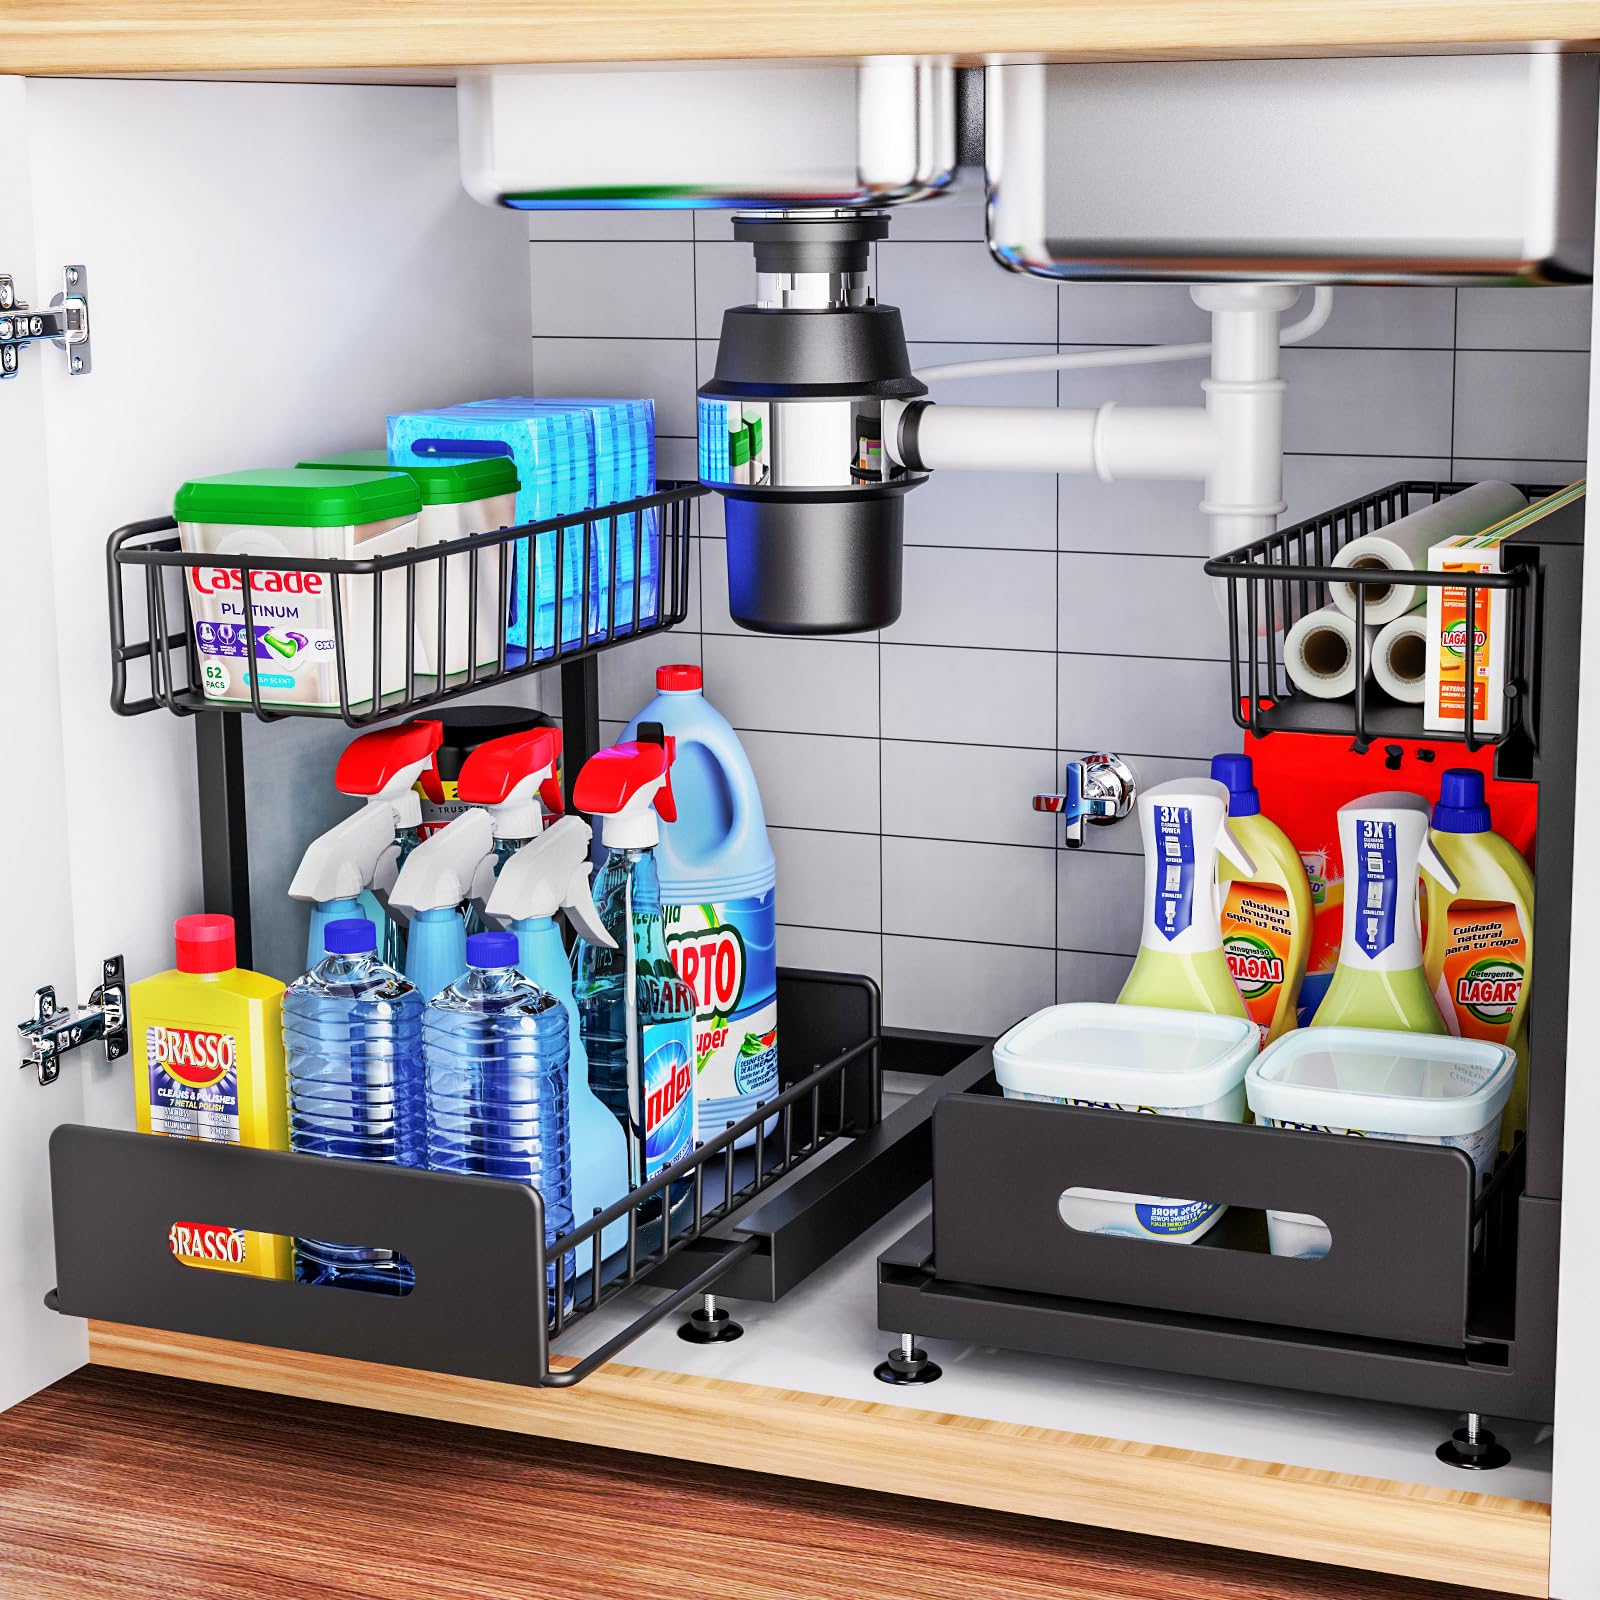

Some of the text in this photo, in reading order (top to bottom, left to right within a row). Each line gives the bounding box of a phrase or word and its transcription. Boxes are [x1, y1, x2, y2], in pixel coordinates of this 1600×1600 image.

[206, 667, 222, 679] 62
[206, 681, 225, 689] PACS
[439, 805, 483, 814] TRUST
[1161, 806, 1180, 823] 3X
[1363, 822, 1383, 838] 3X
[1364, 842, 1385, 850] POWER
[1453, 922, 1502, 936] Cuidado
[1457, 930, 1503, 944] natural
[1445, 944, 1470, 957] para
[1490, 938, 1519, 947] ropa
[1471, 970, 1514, 979] Detergente
[154, 1026, 234, 1071] BRASSO
[696, 1028, 729, 1057] uper
[157, 1088, 189, 1099] CLEANS
[197, 1092, 236, 1105] POLISHES
[175, 1099, 197, 1109] METAL
[199, 1103, 225, 1112] POLISH
